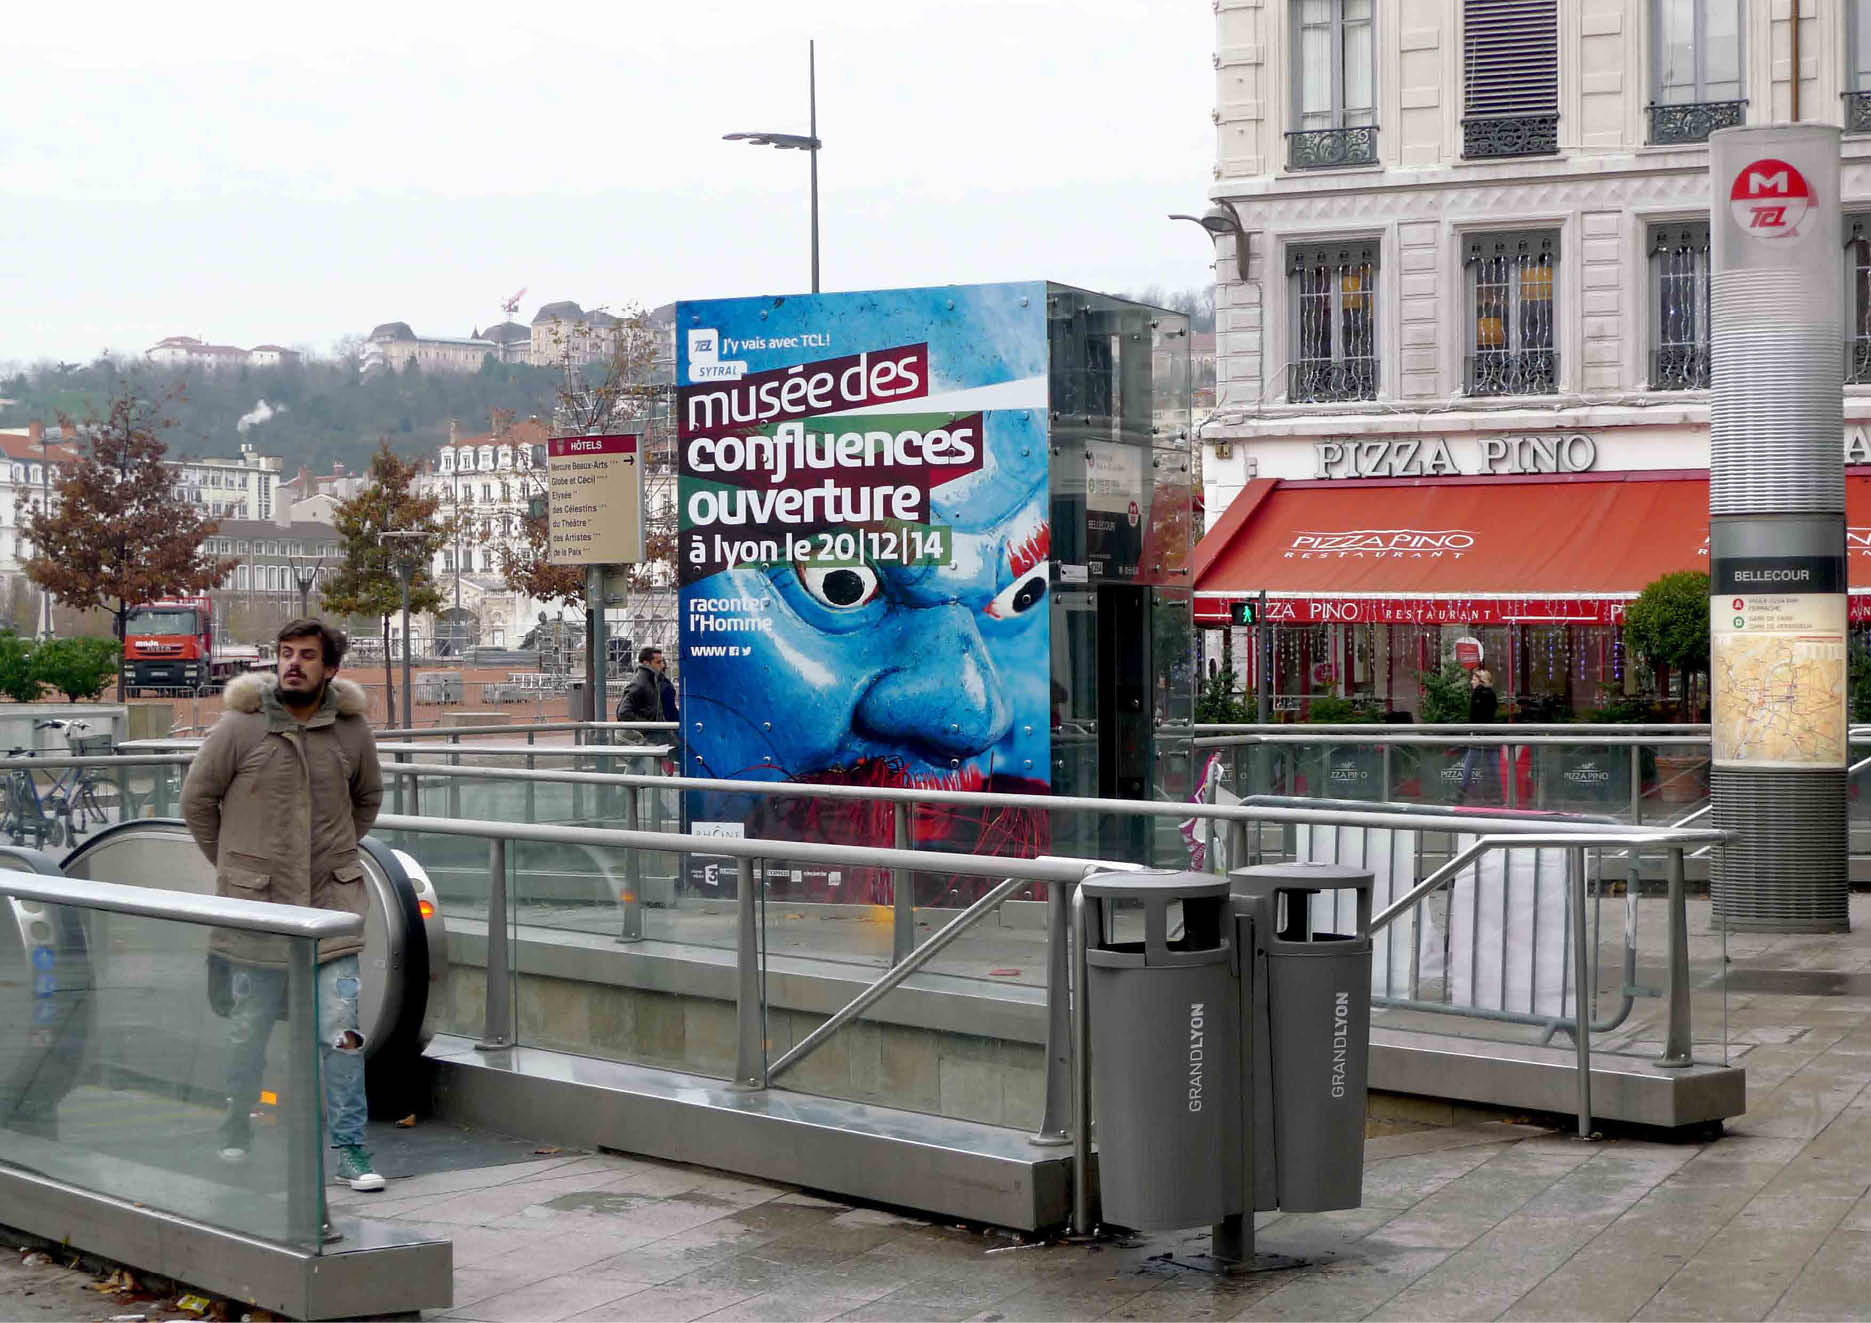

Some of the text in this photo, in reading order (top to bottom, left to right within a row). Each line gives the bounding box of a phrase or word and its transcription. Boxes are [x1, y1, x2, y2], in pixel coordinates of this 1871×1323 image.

[1749, 171, 1788, 194] M
[1749, 206, 1787, 228] TCL
[741, 336, 766, 350] vais
[769, 336, 799, 348] avec
[699, 365, 737, 377] SYTRAL
[689, 352, 919, 431] musée des
[570, 439, 602, 451] HÔTELS
[688, 422, 974, 483] confluences
[1313, 432, 1597, 479] PIZZA PINO
[572, 461, 608, 470] Beaux-Arts
[551, 477, 568, 486] Globe
[569, 477, 576, 485] et
[552, 504, 597, 514] des Célestins
[688, 479, 920, 525] ouverture
[552, 518, 587, 528] du Théâtre
[553, 533, 592, 542] des Artistes
[1292, 534, 1475, 549] PIZZA PINO
[553, 546, 582, 558] de la Paix
[689, 535, 706, 564] à
[714, 534, 778, 569] lyon
[785, 532, 810, 561] le
[1283, 551, 1464, 559] RESTAURANT
[1734, 569, 1809, 581] BELLECOUR
[690, 598, 769, 612] raconter
[1310, 602, 1358, 620] PINO
[1386, 609, 1491, 620] RESTAURANT
[690, 614, 773, 632] l'Homme
[1331, 991, 1349, 1098] GRANDLYON
[1188, 1003, 1205, 1112] GRANDLYON
